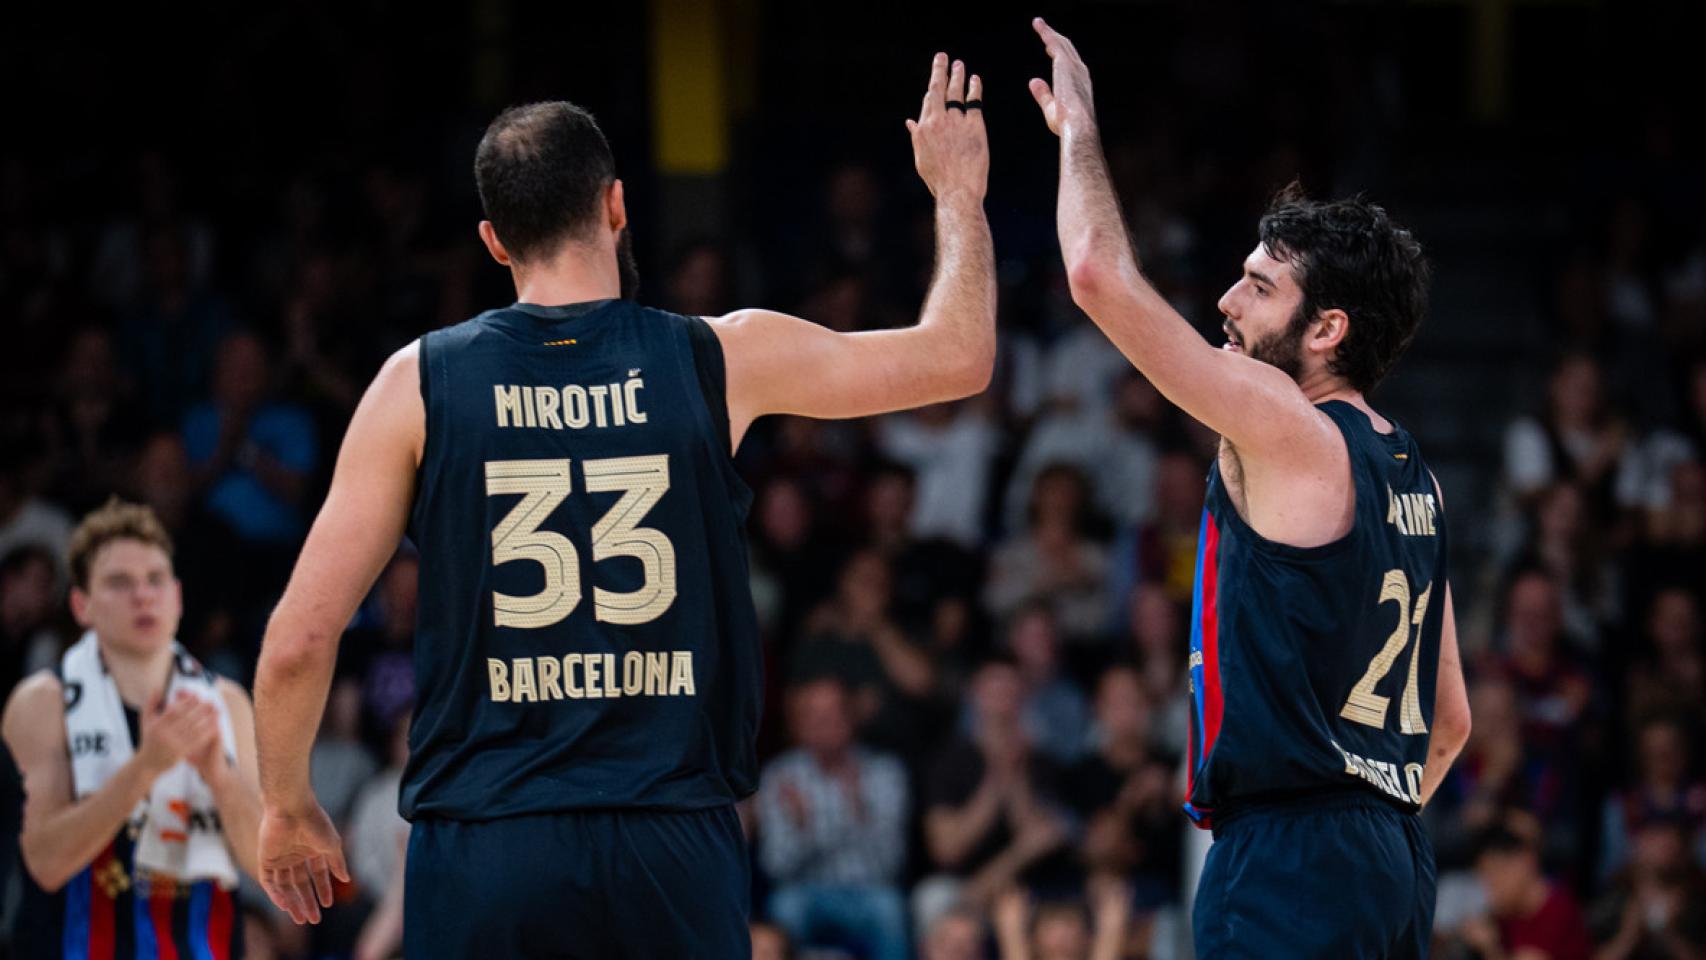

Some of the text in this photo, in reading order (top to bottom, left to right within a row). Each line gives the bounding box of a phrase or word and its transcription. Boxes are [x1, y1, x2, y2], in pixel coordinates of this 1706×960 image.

[494, 368, 647, 430] MIROTIĆ
[485, 454, 678, 629] 33
[488, 651, 696, 703] BARCELONA
[1340, 569, 1432, 734] 21
